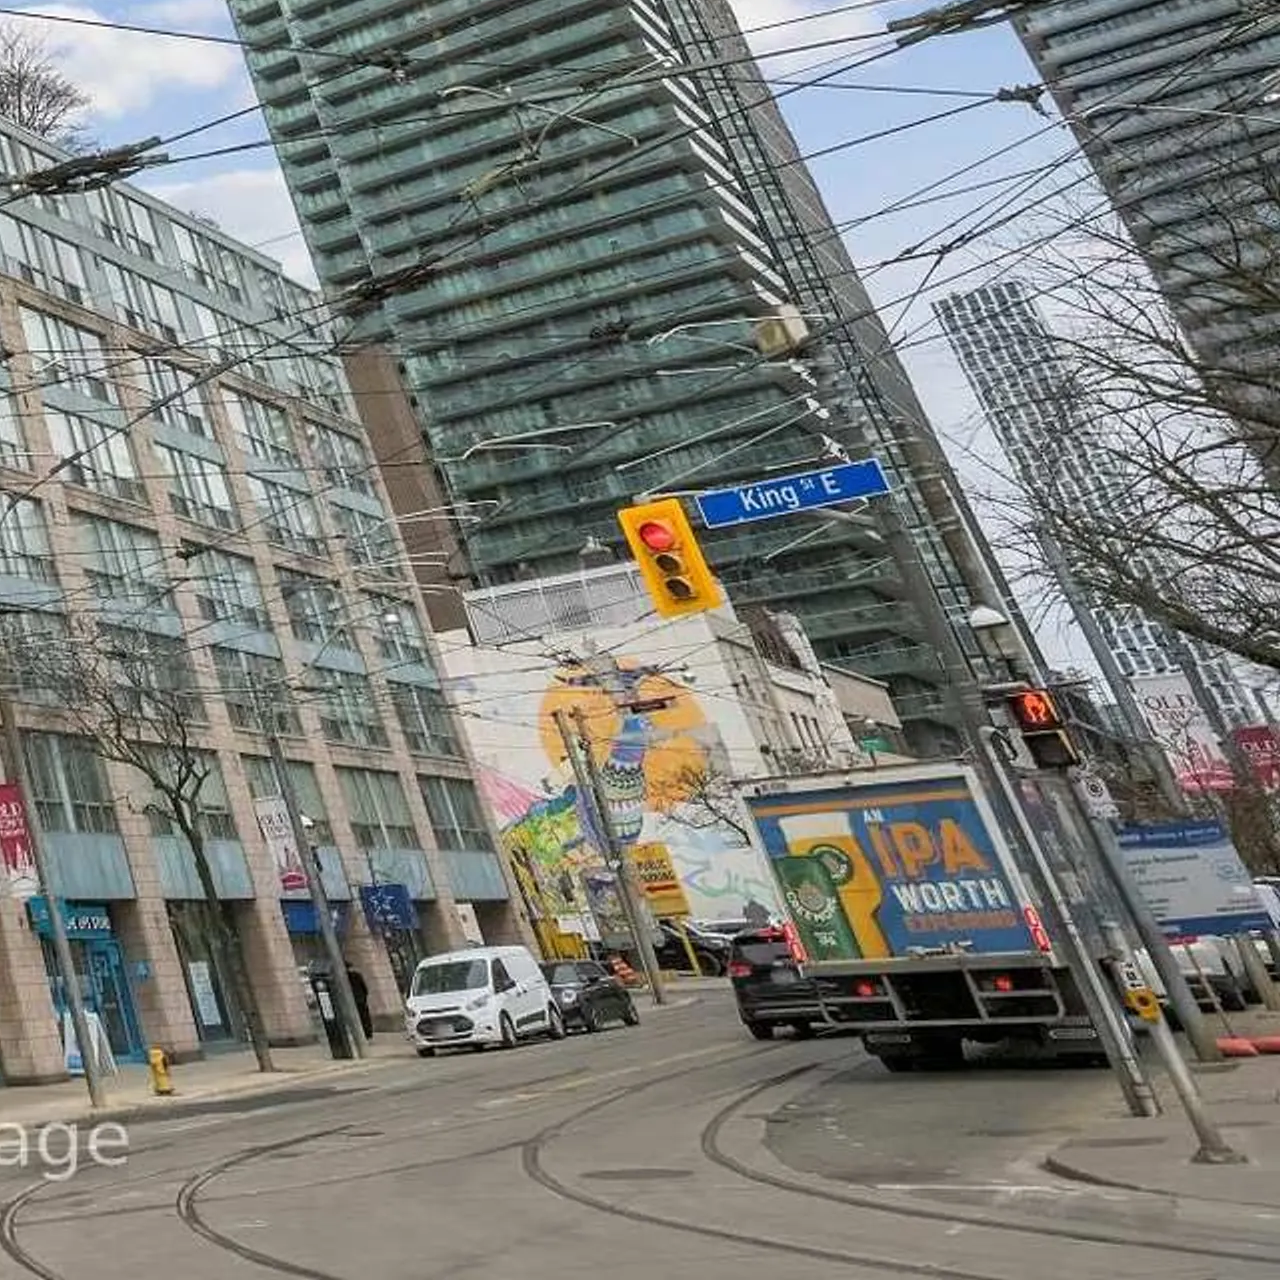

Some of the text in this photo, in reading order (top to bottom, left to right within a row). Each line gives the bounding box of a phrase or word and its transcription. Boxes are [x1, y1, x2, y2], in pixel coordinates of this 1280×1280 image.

[740, 484, 800, 512] King
[820, 472, 841, 496] E
[867, 818, 993, 881] IPA
[893, 878, 1012, 915] WORTH
